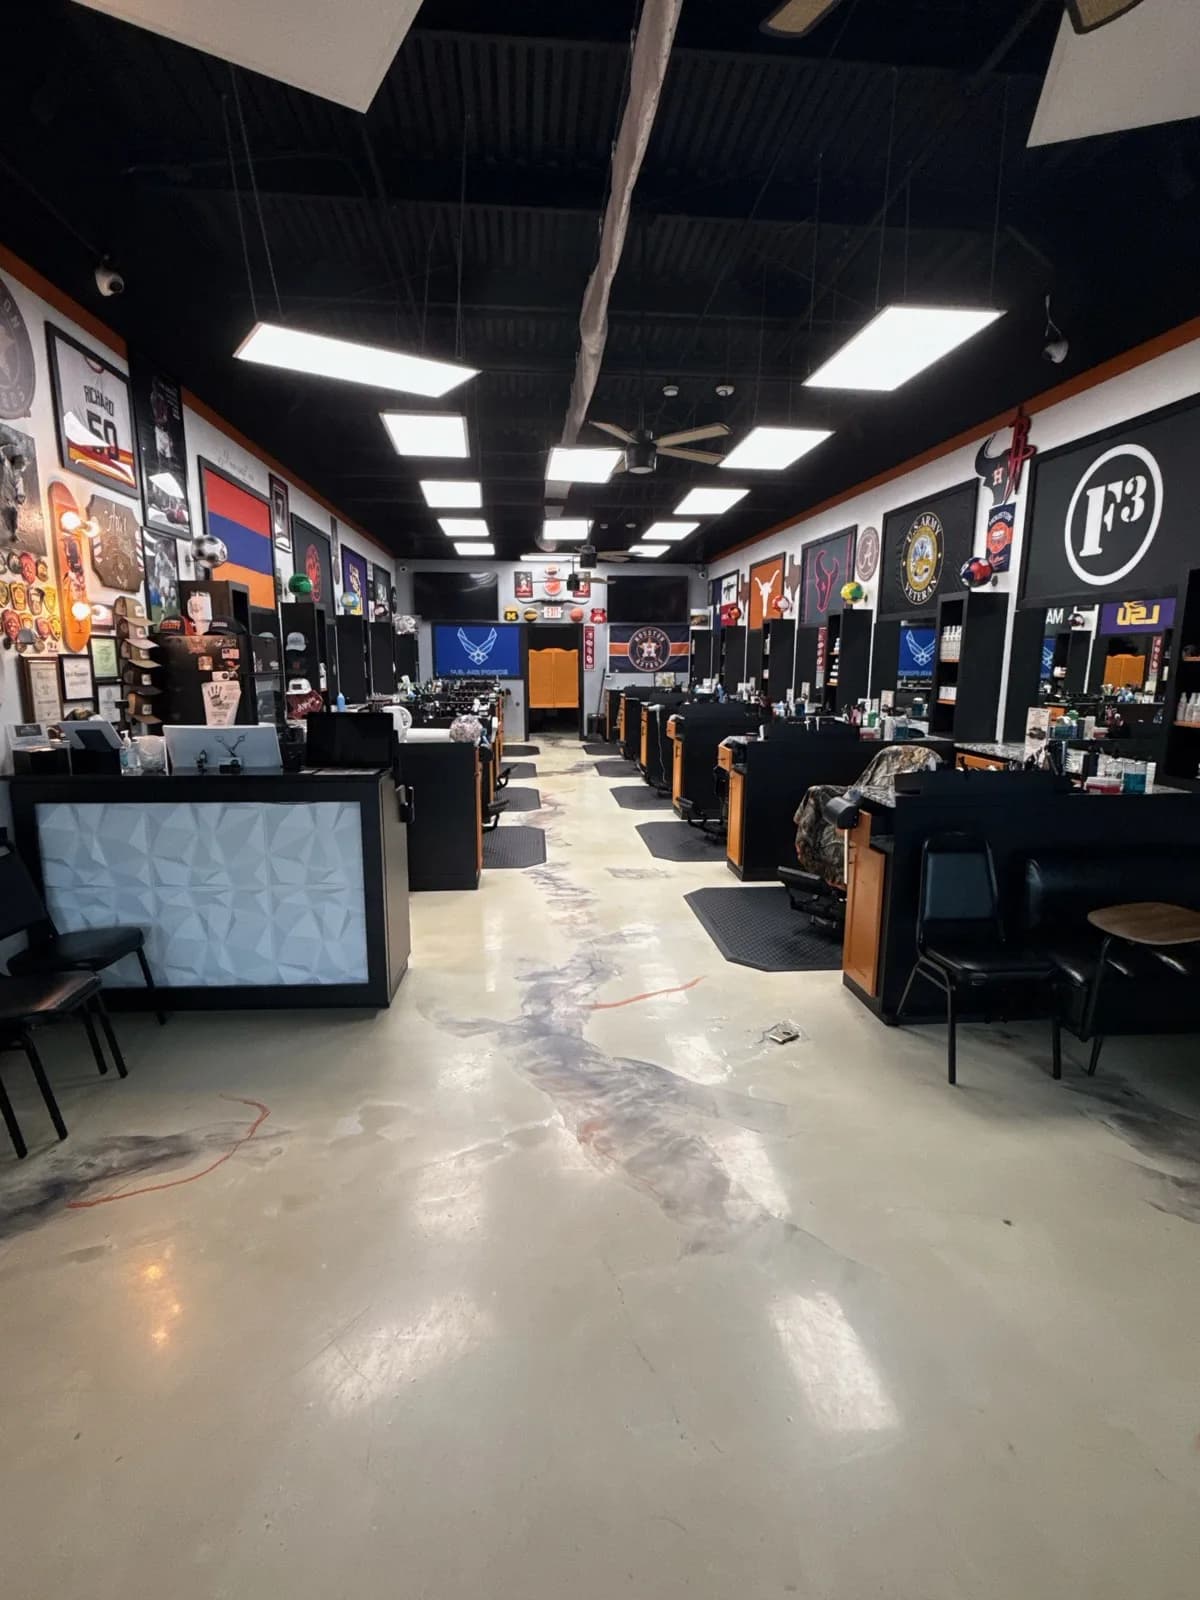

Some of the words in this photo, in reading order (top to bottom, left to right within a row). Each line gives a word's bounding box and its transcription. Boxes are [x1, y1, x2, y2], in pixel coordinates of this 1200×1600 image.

[84, 385, 114, 417] RICHARD
[87, 409, 120, 461] 50
[920, 515, 943, 537] ARMY
[905, 575, 937, 602] VETERAN
[547, 608, 559, 617] EXIT
[634, 629, 665, 642] HOUSTON
